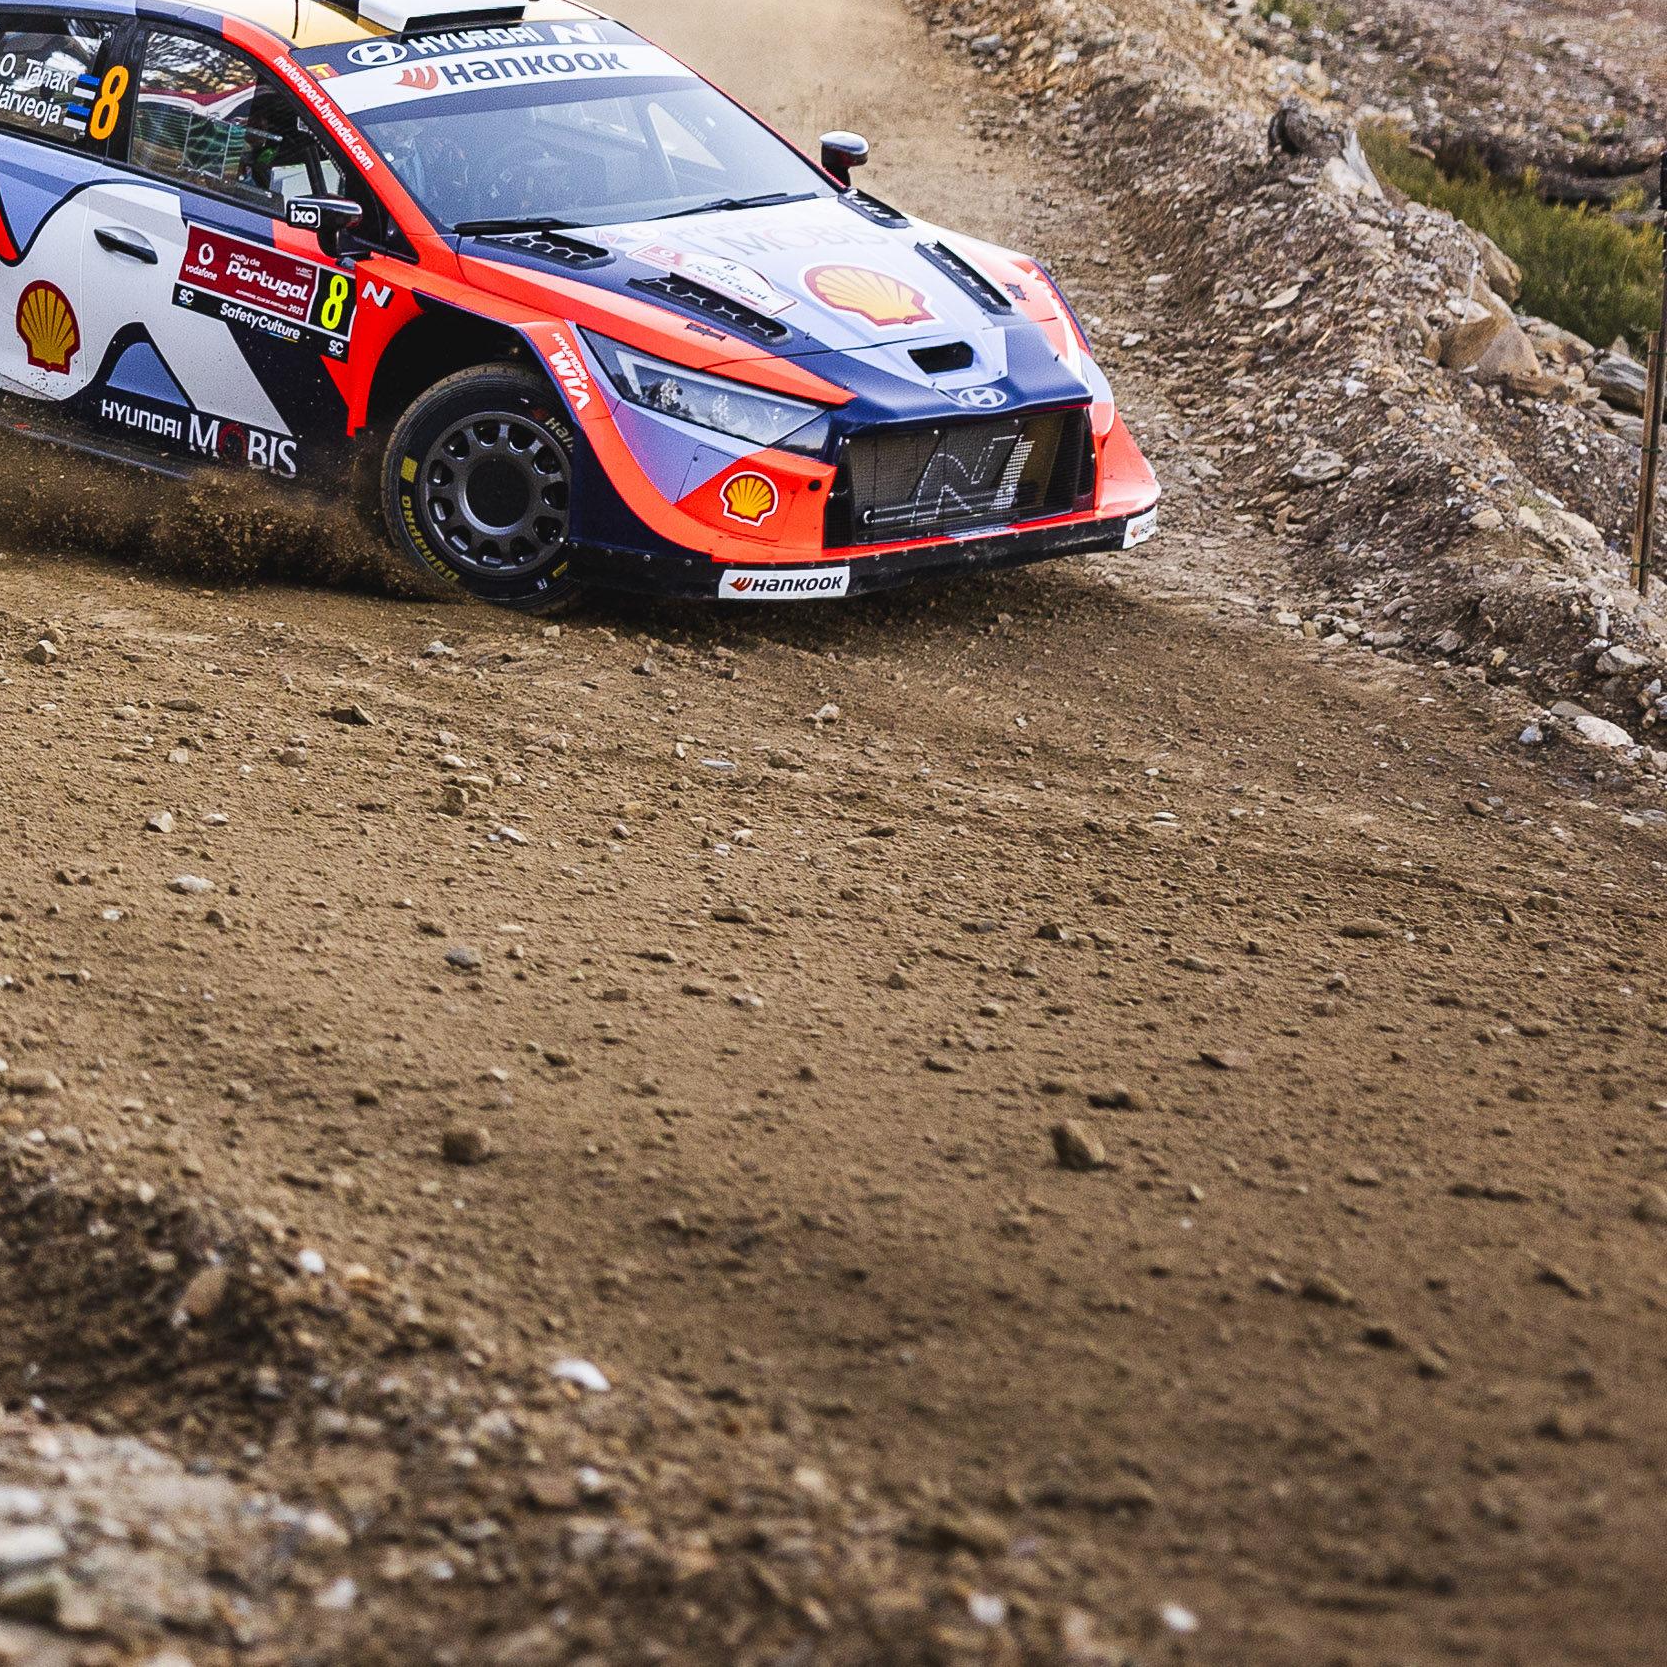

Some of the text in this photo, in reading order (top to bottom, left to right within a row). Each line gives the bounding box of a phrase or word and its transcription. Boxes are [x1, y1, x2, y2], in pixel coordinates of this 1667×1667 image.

[407, 26, 547, 56] HYUNDAI
[0, 53, 73, 94] O. Tänak
[90, 65, 129, 140] 8
[273, 55, 375, 171] motorsport.hyundai.com
[290, 203, 318, 224] ixo
[713, 224, 891, 256] MOBIS
[185, 263, 218, 282] vodafone
[226, 260, 309, 302] Portugal
[178, 288, 195, 304] SC
[320, 274, 349, 330] 8
[361, 280, 396, 309] N
[220, 302, 301, 340] SafetyCulture
[328, 339, 344, 355] SC
[551, 332, 590, 381] HYUNDAI
[101, 399, 183, 440] HYUNDAI
[188, 413, 298, 480] MOBIS
